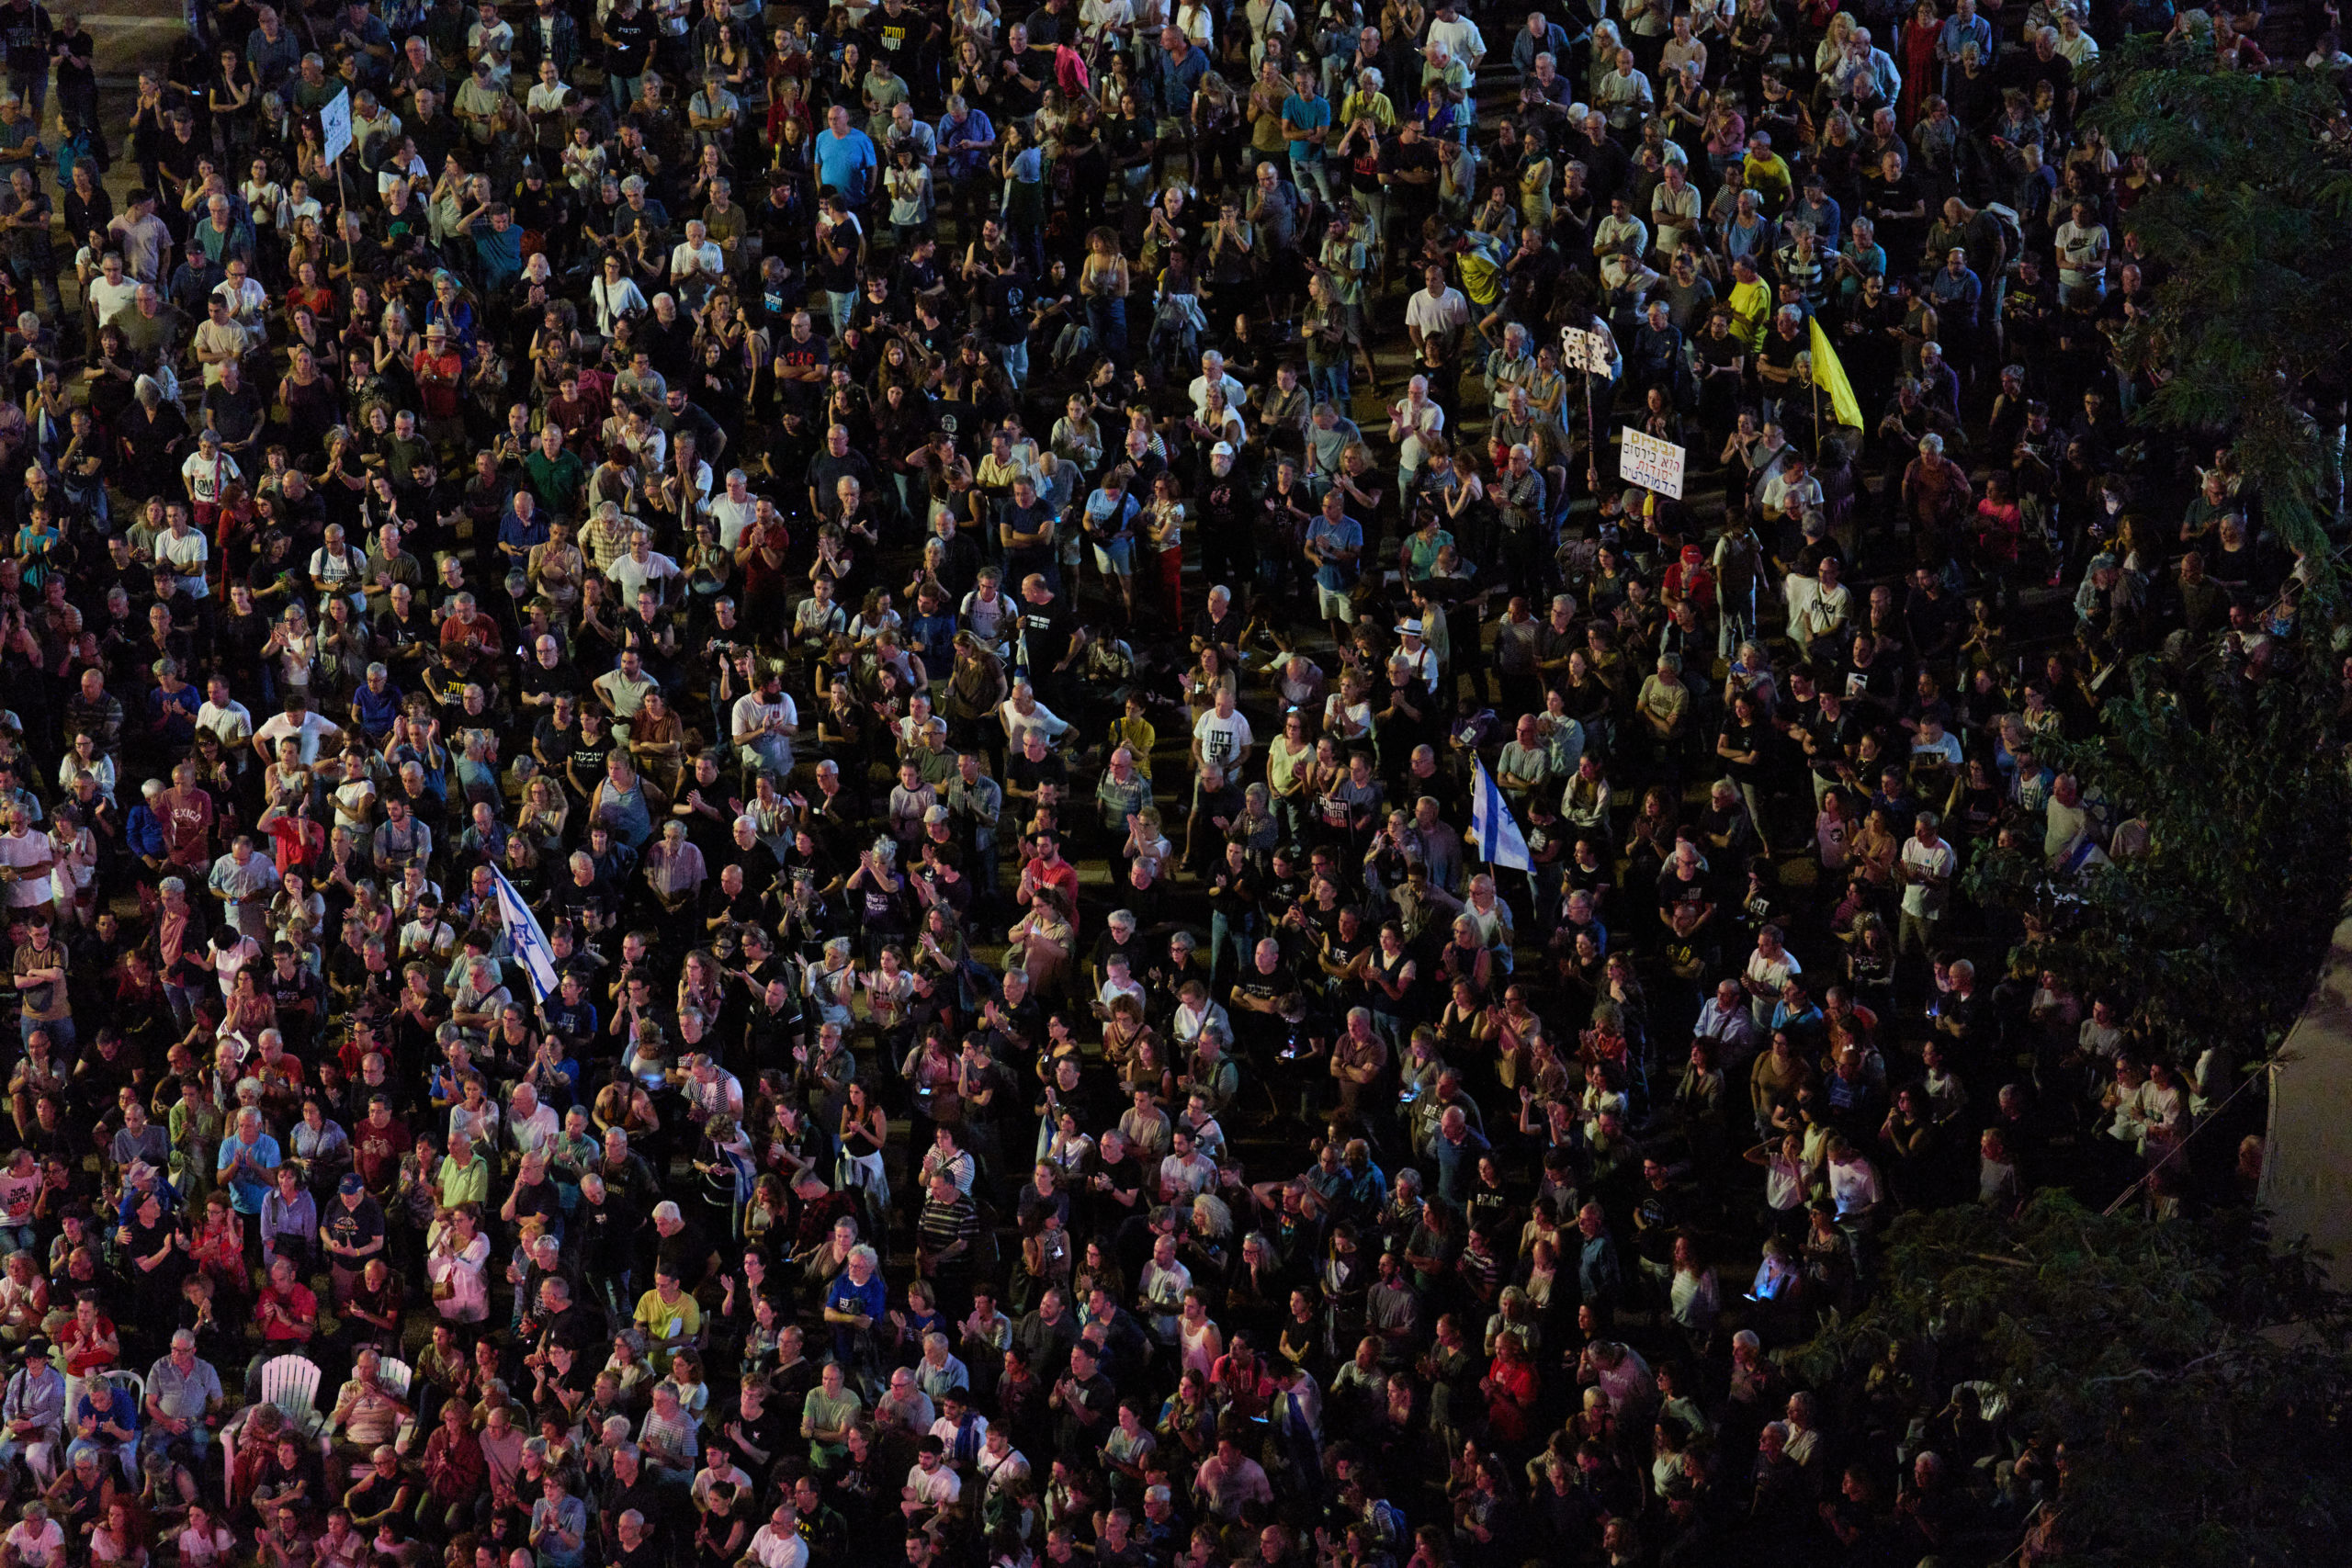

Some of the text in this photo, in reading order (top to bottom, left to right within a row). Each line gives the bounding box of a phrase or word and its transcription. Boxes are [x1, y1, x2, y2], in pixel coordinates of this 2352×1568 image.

[1623, 443, 1680, 473] הוא כירסום
[1636, 460, 1673, 480] יסודות
[1623, 465, 1677, 494] הדמוקרטיה
